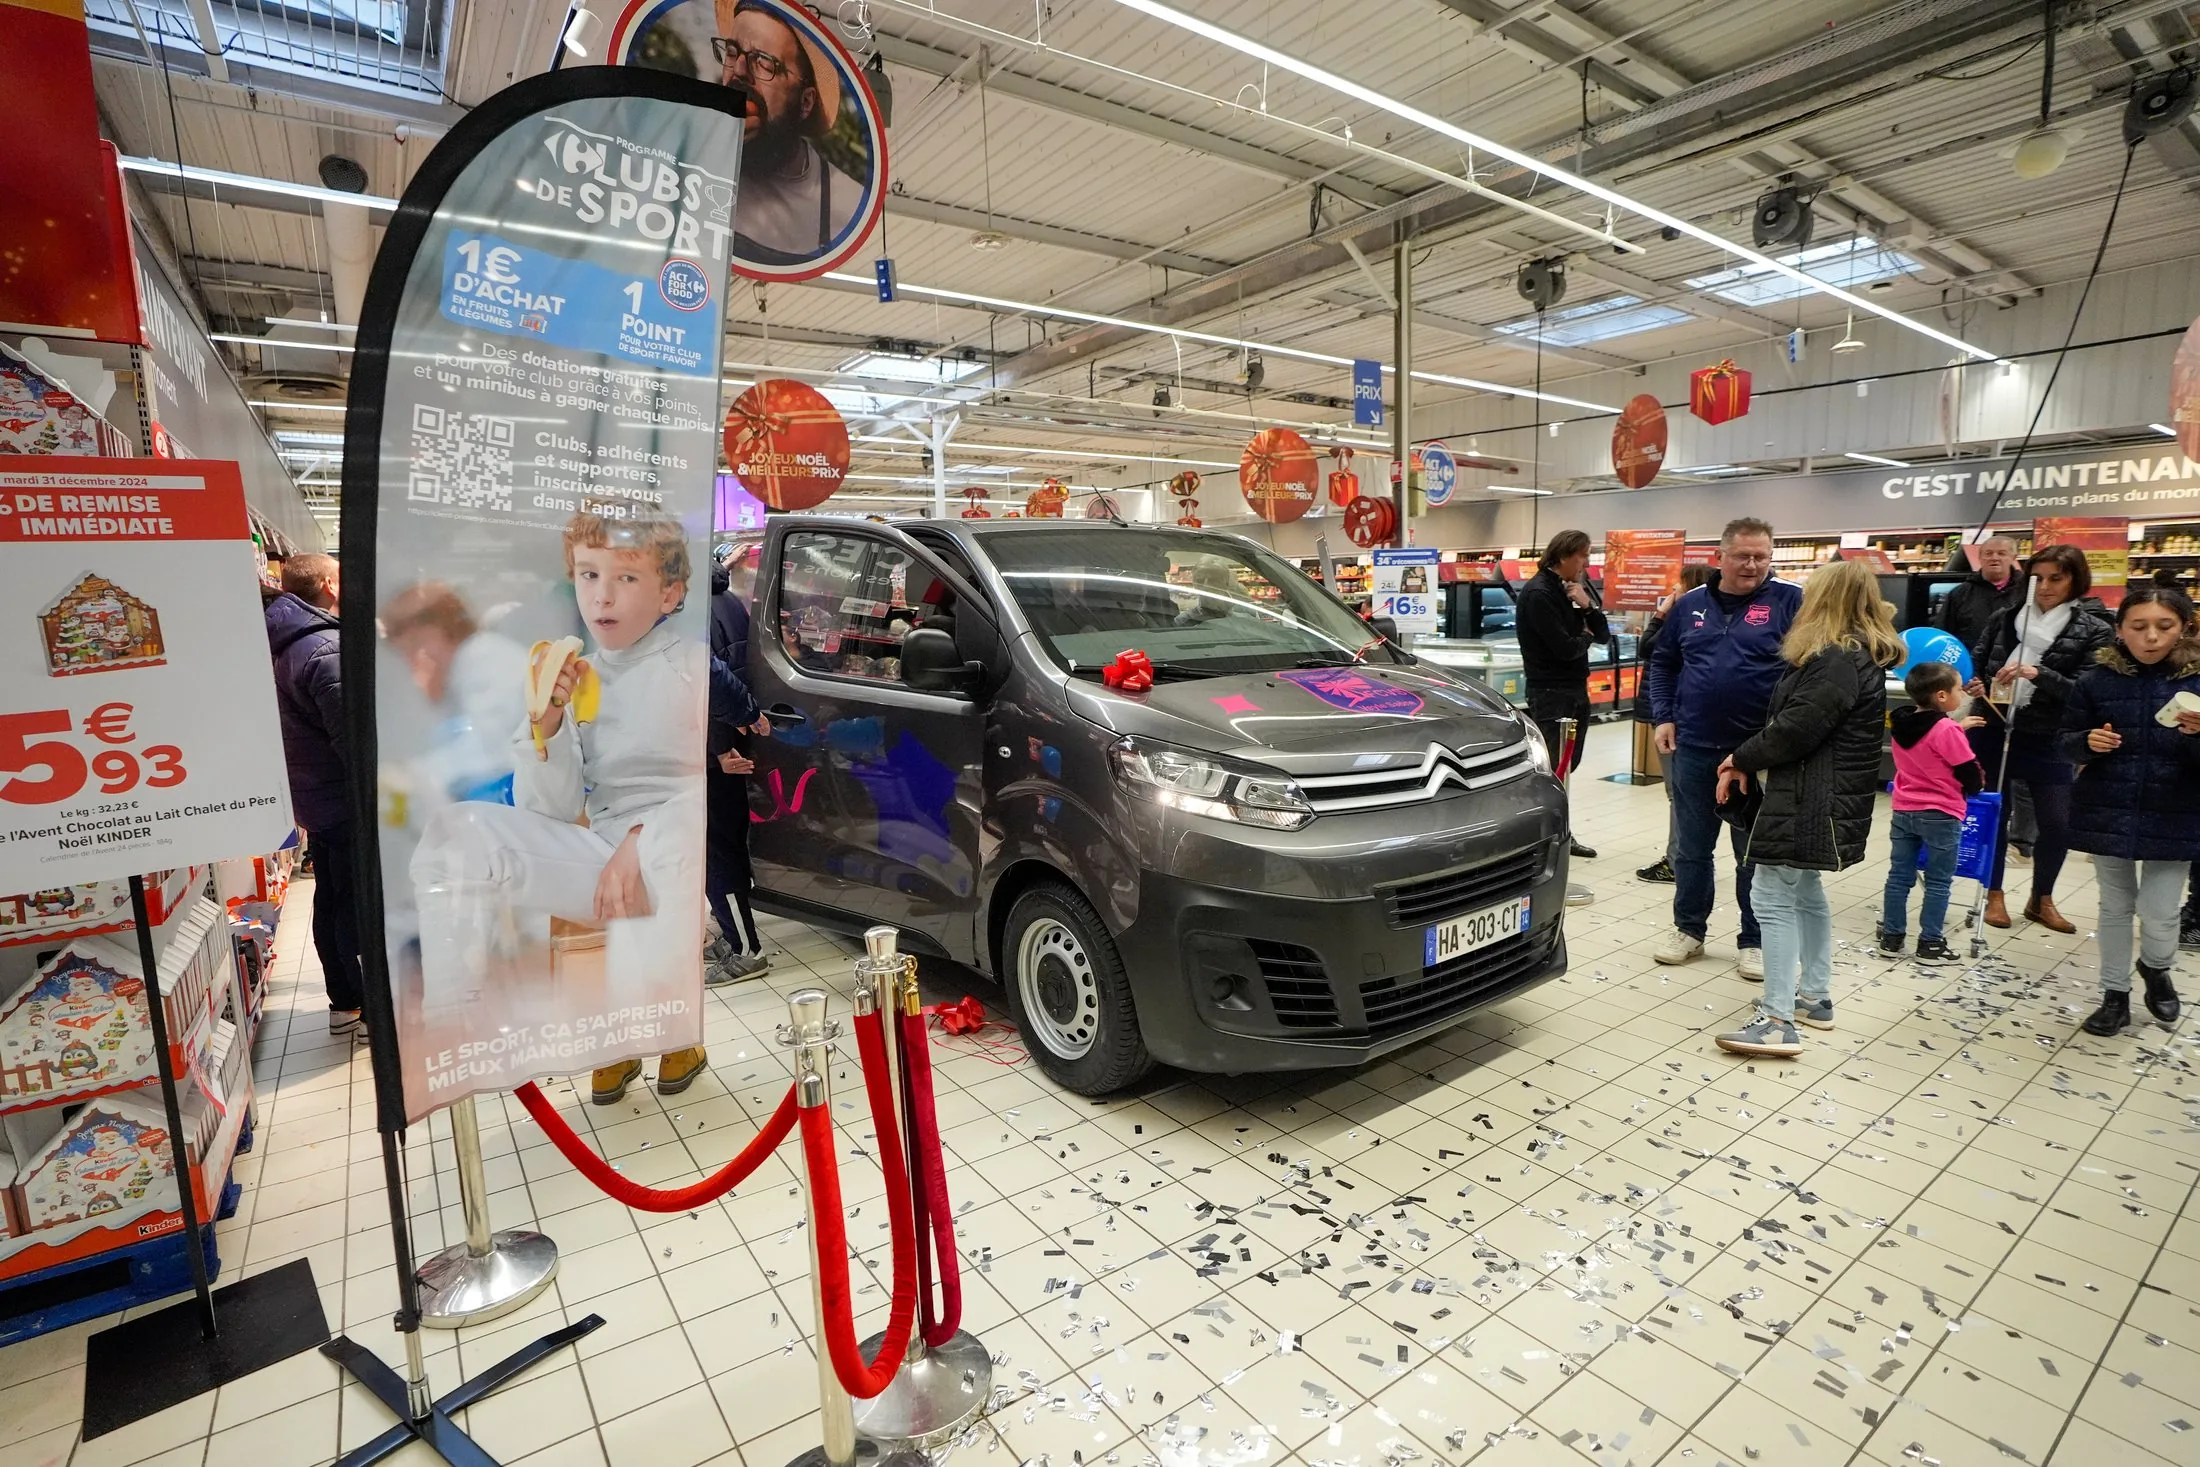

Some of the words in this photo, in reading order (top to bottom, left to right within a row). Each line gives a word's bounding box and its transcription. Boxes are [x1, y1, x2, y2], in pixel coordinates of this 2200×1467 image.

[616, 136, 679, 166] PROGRAMME
[535, 178, 573, 208] DE
[576, 182, 732, 261] SPORT
[457, 239, 523, 285] 1€
[669, 280, 686, 290] FOR
[670, 271, 688, 282] ACT
[452, 294, 467, 306] EN
[468, 297, 509, 318] FRUITS
[454, 273, 566, 315] D'ACHAT
[623, 281, 643, 315] 1
[668, 289, 693, 299] FOOD
[136, 256, 208, 404] AINTENANT
[621, 314, 686, 345] POINT
[618, 343, 629, 353] DE
[629, 345, 661, 362] SPORT
[662, 353, 697, 368] FAVORI
[620, 333, 641, 349] POUR
[643, 340, 676, 356] VOTRE
[677, 346, 702, 361] CLUB
[482, 342, 517, 361] Des
[522, 351, 600, 377] dotations
[603, 368, 668, 393] gratuites
[435, 352, 478, 373] pour
[482, 361, 526, 381] votre
[530, 368, 563, 389] club
[568, 377, 609, 397] grâce
[612, 384, 620, 399] à
[624, 391, 651, 406] vos
[655, 395, 702, 417] points,
[1355, 385, 1381, 400] PRIX
[414, 364, 432, 379] et
[437, 370, 461, 385] un
[467, 373, 536, 400] minibus
[540, 388, 550, 403] à
[555, 394, 610, 414] gagner
[612, 403, 671, 426] chaque
[674, 416, 708, 433] mois
[535, 432, 592, 457] Clubs,
[597, 444, 688, 471] adhérents
[749, 452, 797, 466] JOYEUX
[795, 450, 830, 468] NOËL
[535, 454, 555, 468] et
[560, 457, 661, 487] supporters,
[1426, 459, 1440, 471] ACT
[4, 475, 39, 485] mardi
[41, 476, 56, 486] 31
[59, 476, 116, 487] décembre
[119, 477, 148, 487] 2024
[534, 471, 663, 504] inscrivez-vous
[1285, 480, 1306, 491] NOËL
[1882, 472, 1971, 500] C'EST
[15, 494, 54, 513] DE
[60, 495, 161, 513] REMISE
[533, 493, 575, 513] dans
[580, 499, 626, 521] l'app
[631, 504, 637, 519] !
[1996, 493, 2022, 509] Les
[2026, 492, 2068, 508] bons
[2072, 489, 2120, 507] plans
[2123, 486, 2148, 501] du
[20, 514, 174, 535] IMMÉDIATE
[1385, 596, 1411, 615] 16
[1412, 606, 1426, 614] 39
[0, 709, 88, 805] 5
[82, 702, 136, 744] €
[92, 744, 187, 795] 93
[10, 825, 63, 842] l'Avent
[67, 814, 131, 833] Chocolat
[135, 812, 152, 824] au
[156, 807, 181, 821] Lait
[184, 803, 226, 817] Chalet
[230, 798, 246, 811] du
[249, 795, 277, 808] Père
[60, 810, 73, 819] Le
[75, 808, 90, 819] kg
[98, 803, 129, 814] 32,23
[131, 800, 139, 809] €
[58, 834, 93, 850] Noël
[97, 827, 151, 844] KINDER
[40, 850, 79, 863] Calendrier
[80, 849, 90, 858] de
[117, 843, 127, 852] 24
[1521, 913, 1529, 926] 14
[51, 966, 81, 984] Joyeux
[69, 1003, 93, 1011] Kinder
[425, 1047, 453, 1073] LE
[458, 1025, 534, 1060] SPORT,
[540, 1022, 572, 1044] ÇA
[576, 1000, 690, 1035] S'APPREND,
[428, 1057, 504, 1093] MIEUX
[510, 1037, 597, 1070] MANGER
[603, 1022, 666, 1048] AUSSI.
[77, 1123, 105, 1140] Joyeux
[94, 1156, 117, 1164] Kinder
[138, 1217, 183, 1236] Kinder
